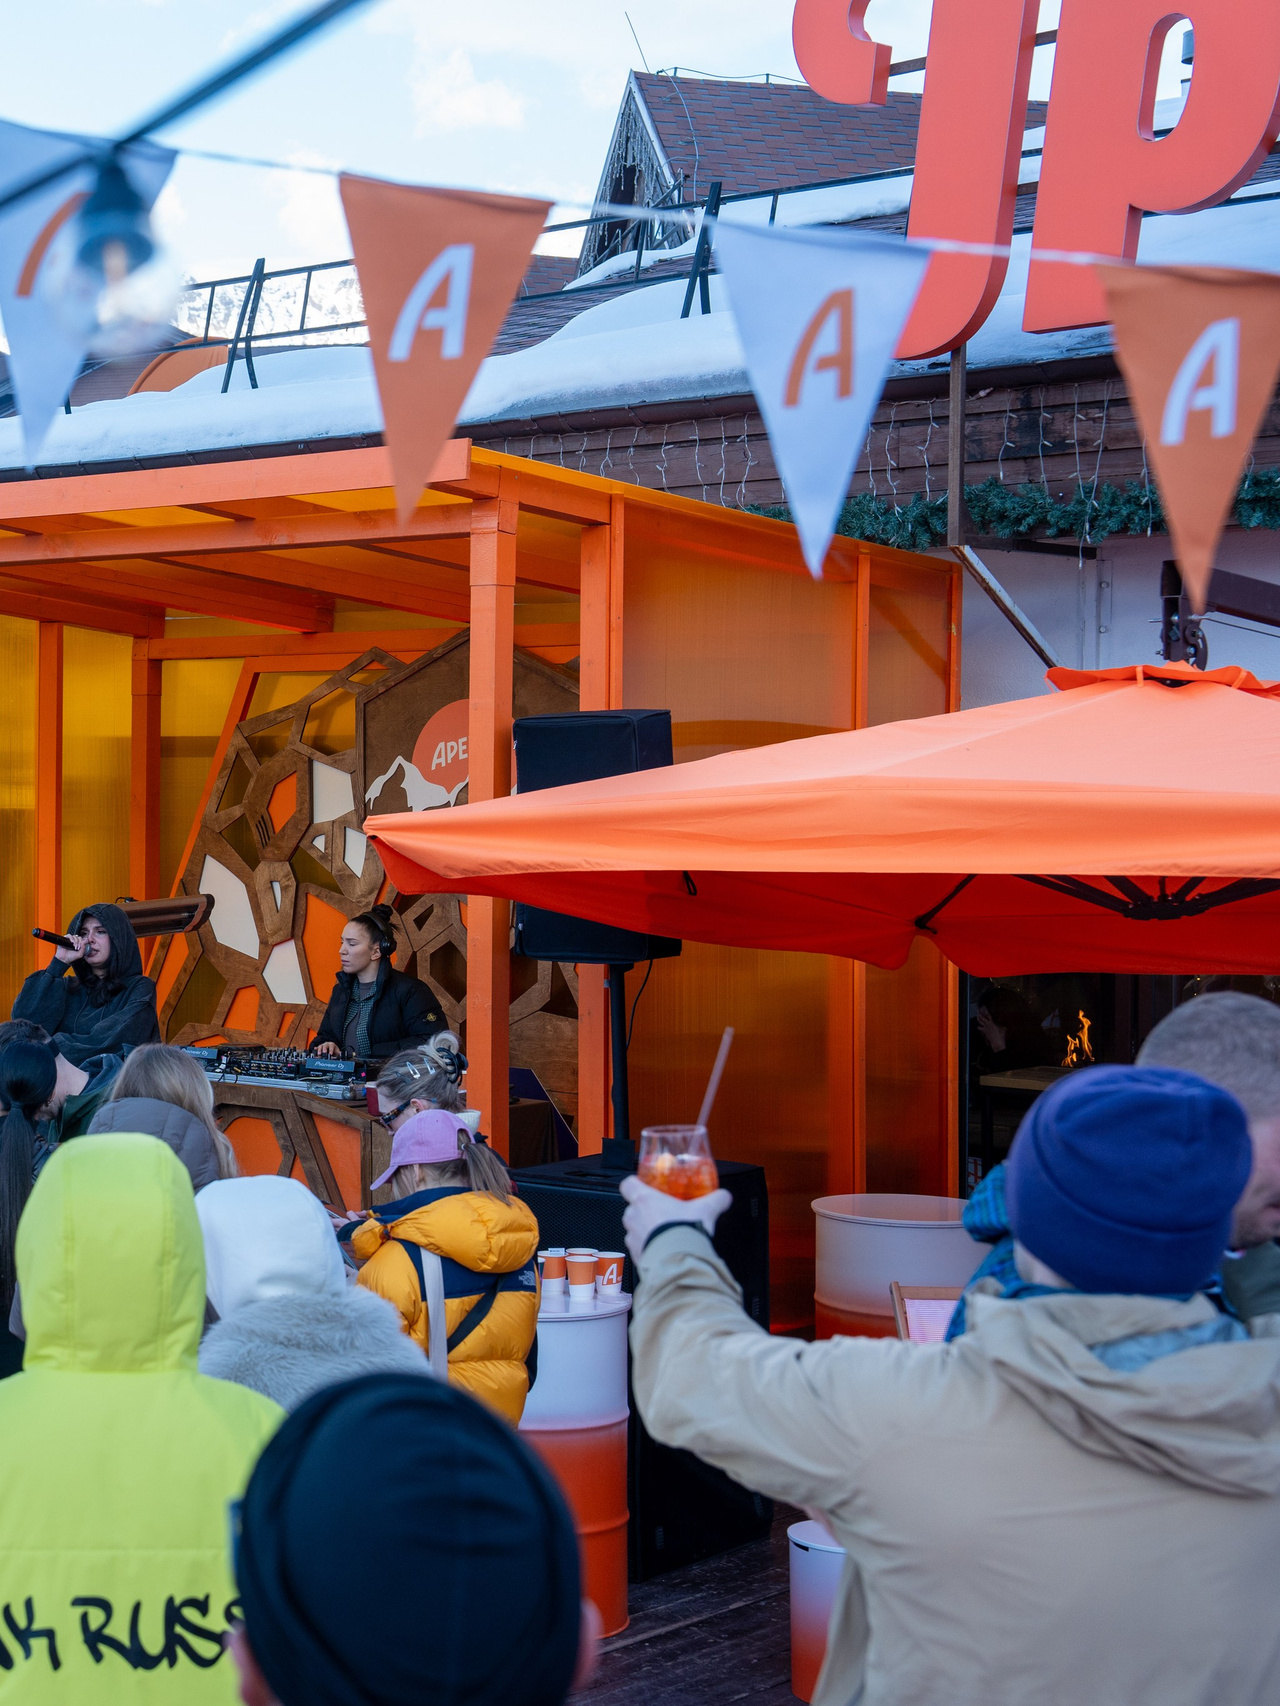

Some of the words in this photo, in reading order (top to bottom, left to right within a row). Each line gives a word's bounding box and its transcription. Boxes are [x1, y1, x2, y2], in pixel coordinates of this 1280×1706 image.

[387, 242, 475, 363] A
[782, 286, 856, 409] A
[1160, 316, 1240, 446] A
[431, 737, 468, 771] APE
[603, 1263, 617, 1285] A
